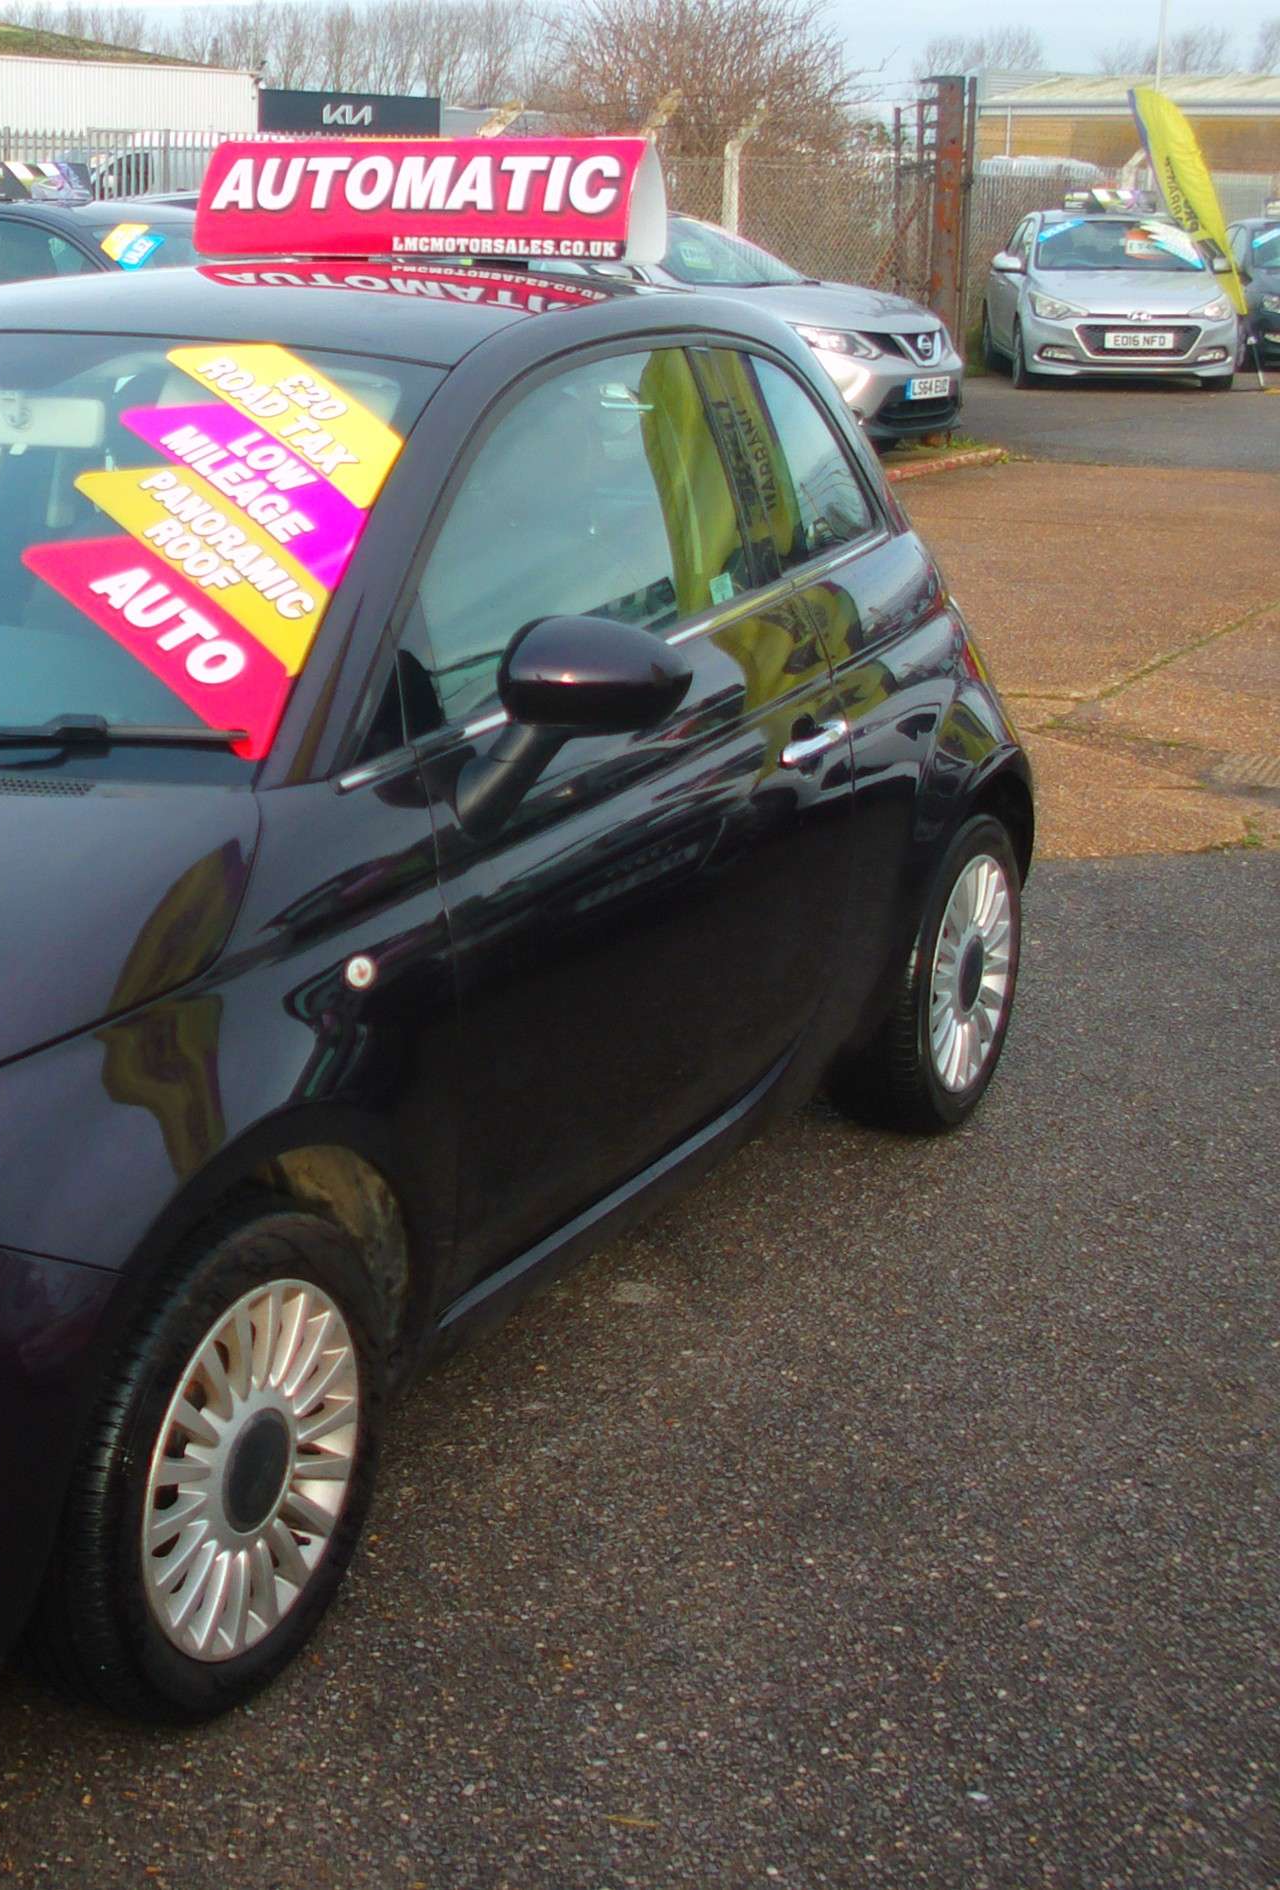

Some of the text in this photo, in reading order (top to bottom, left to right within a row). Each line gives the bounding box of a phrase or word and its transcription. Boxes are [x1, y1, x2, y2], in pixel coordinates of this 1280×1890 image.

[323, 103, 372, 126] KIA
[210, 155, 620, 214] AUTOMATIC
[391, 236, 617, 258] LMCMOTORSALES.CO.UK
[196, 357, 360, 475] ROAD TAX
[275, 375, 348, 422] £20
[160, 425, 315, 544] MILEAGE
[227, 431, 318, 492] LOW
[139, 471, 316, 620] PANORAMIC
[143, 519, 243, 590] ROOF
[88, 566, 246, 685] AUTO
